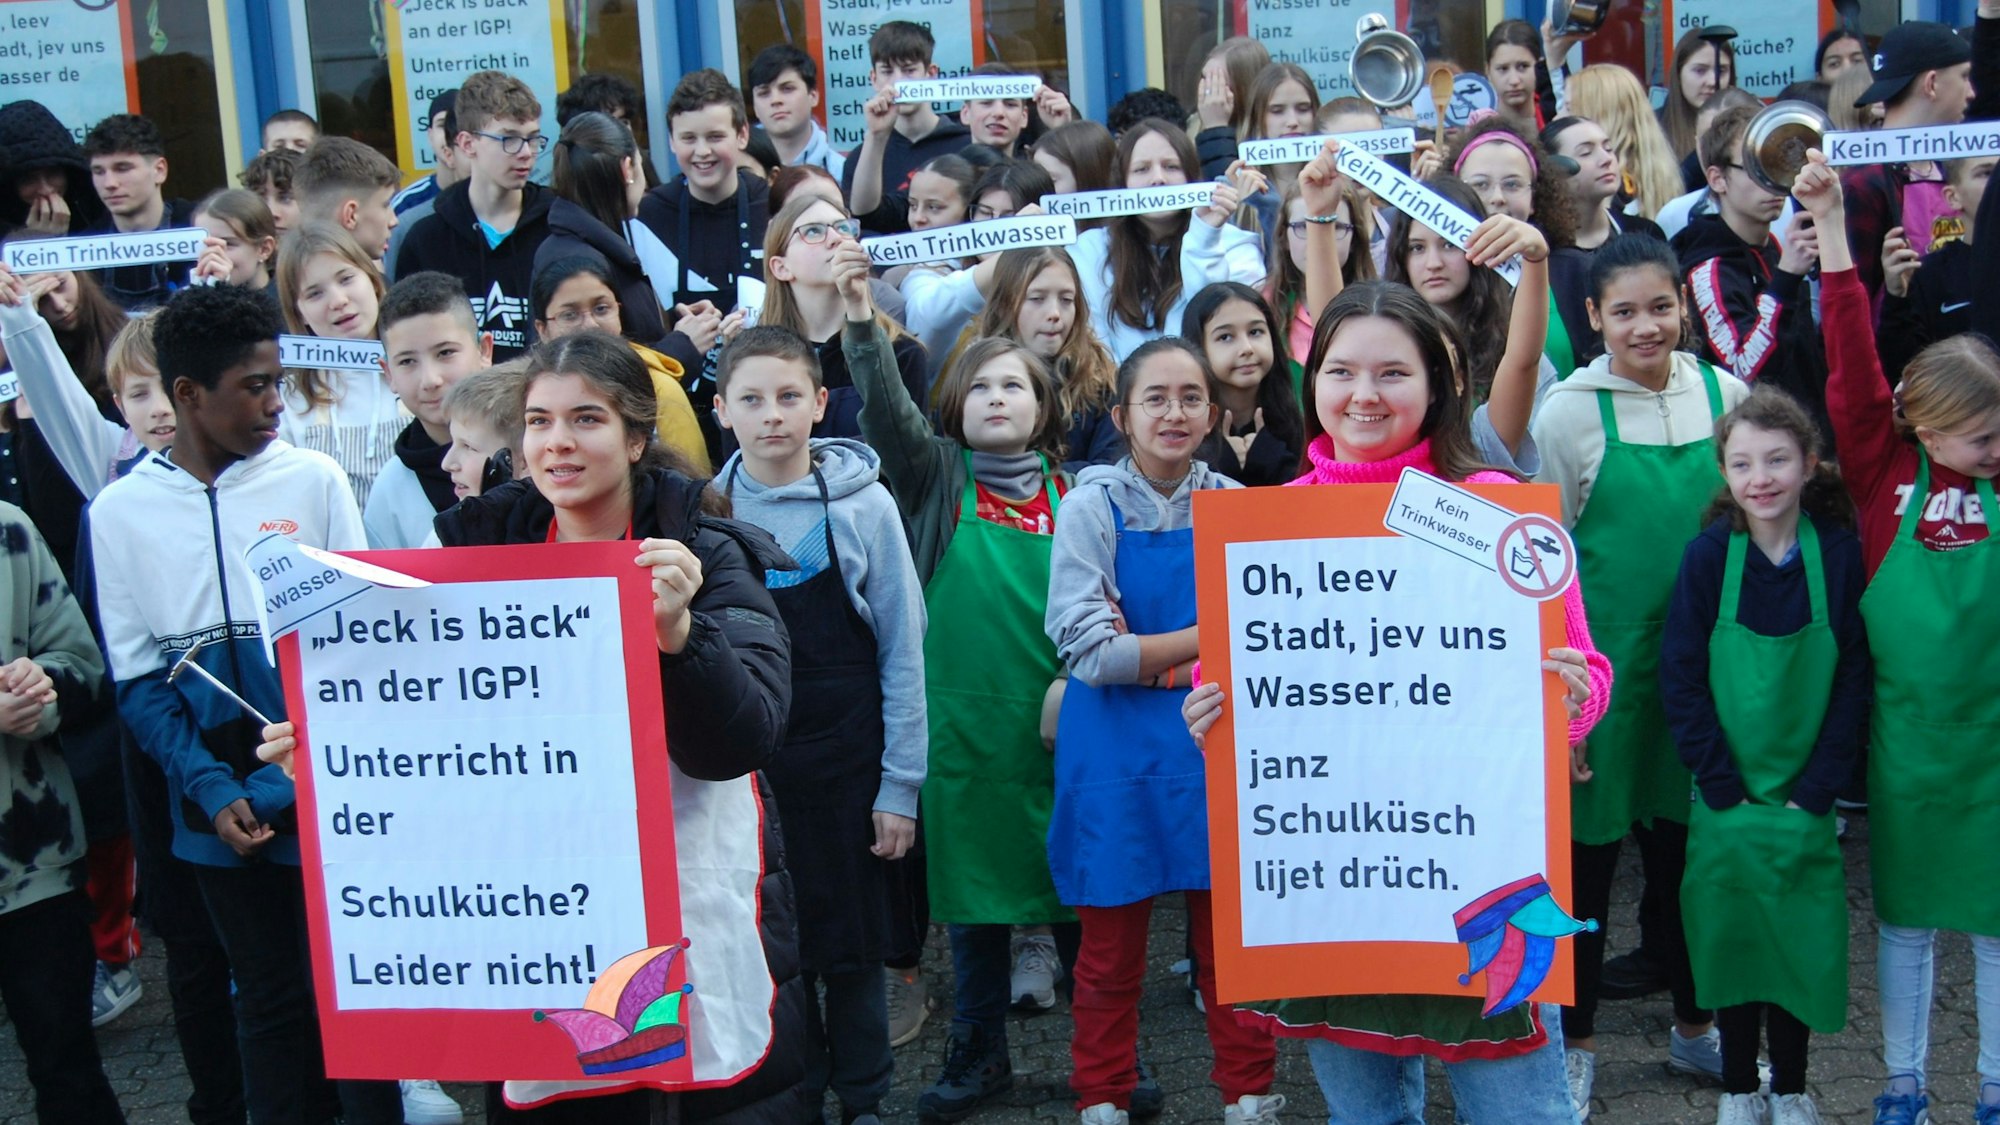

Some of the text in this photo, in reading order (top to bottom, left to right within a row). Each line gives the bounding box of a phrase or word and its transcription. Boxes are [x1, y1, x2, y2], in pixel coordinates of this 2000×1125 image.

[11, 14, 49, 29] leev
[409, 19, 511, 39] an der IGP!
[1680, 13, 1709, 28] der
[38, 40, 64, 60] jev
[72, 41, 105, 54] uns
[412, 53, 530, 74] Unterricht in
[829, 45, 864, 61] helf
[59, 67, 80, 82] de
[899, 81, 1037, 98] Kein Trinkwasser
[1246, 146, 1286, 161] Kein
[1832, 137, 1887, 160] Kein
[1337, 146, 1383, 185] Kein
[1047, 186, 1213, 216] Kein Trinkwasser
[12, 238, 200, 268] Kein Trinkwasser
[868, 221, 1067, 262] Kein Trinkwasser
[1435, 496, 1470, 522] Kein
[1400, 503, 1492, 554] Trinkwasser
[1243, 562, 1398, 600] Oh, leev
[312, 604, 590, 650] „Jeck is bäck“
[1245, 617, 1507, 657] Stadt, jev uns
[318, 665, 540, 702] an der IGP!
[1408, 674, 1451, 705] de
[325, 741, 578, 777] Unterricht in
[1249, 749, 1329, 789] janz
[332, 803, 394, 835] der
[1252, 800, 1475, 836] Schulküsch
[1255, 856, 1459, 899] lijet drüch.
[341, 883, 590, 918] Schulküche?
[349, 945, 596, 985] Leider nicht!
